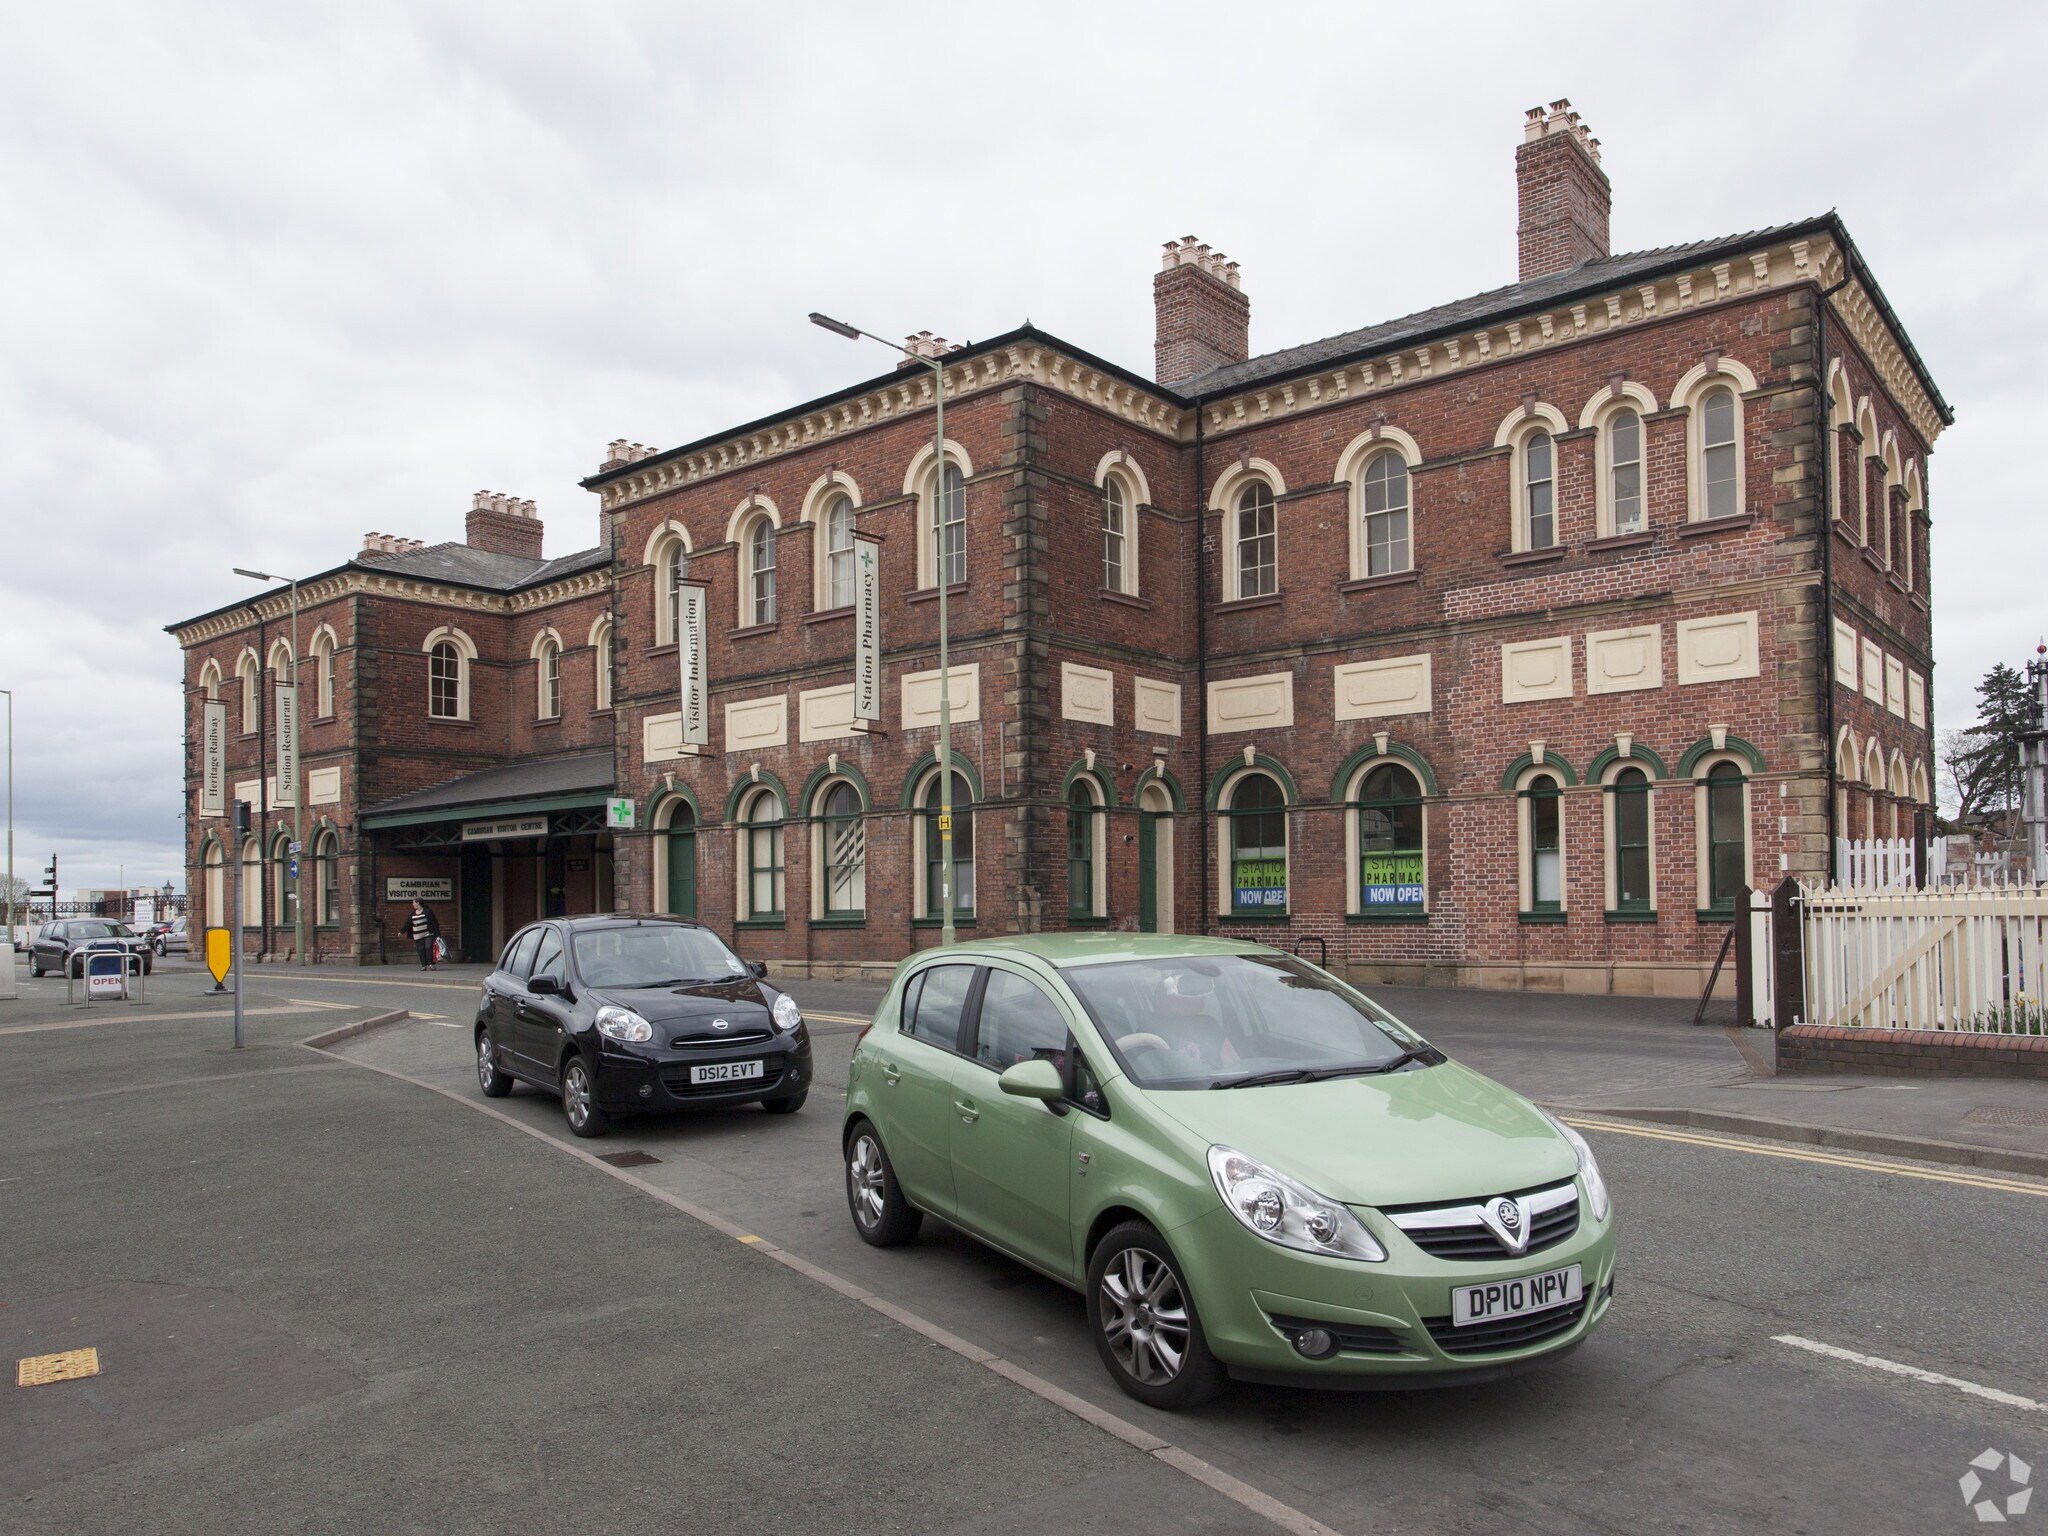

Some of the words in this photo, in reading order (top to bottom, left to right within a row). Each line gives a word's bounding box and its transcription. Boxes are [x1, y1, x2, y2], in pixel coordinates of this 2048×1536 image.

[862, 571, 874, 648] Pharmacy
[686, 598, 699, 682] Information
[862, 656, 872, 710] Station
[689, 686, 699, 732] Visitor
[209, 716, 220, 754] Railway
[282, 696, 291, 752] Restaurant
[209, 756, 220, 796] Heritage
[282, 755, 292, 790] Station
[467, 825, 494, 836] CAMBRIAN
[497, 823, 517, 833] VISITOR
[520, 822, 543, 831] CENTRE
[940, 817, 949, 828] H
[1372, 857, 1423, 870] STATION
[1238, 876, 1286, 887] PHARMAC
[1366, 872, 1421, 884] PHARMAC
[1240, 890, 1262, 904] NOW
[1370, 888, 1395, 902] NOW
[1397, 887, 1424, 901] OPEN
[93, 977, 122, 986] OPEN
[698, 1066, 728, 1080] DS12
[731, 1063, 756, 1078] EVT
[1469, 1282, 1524, 1318] DP10
[1530, 1271, 1569, 1306] NPV
